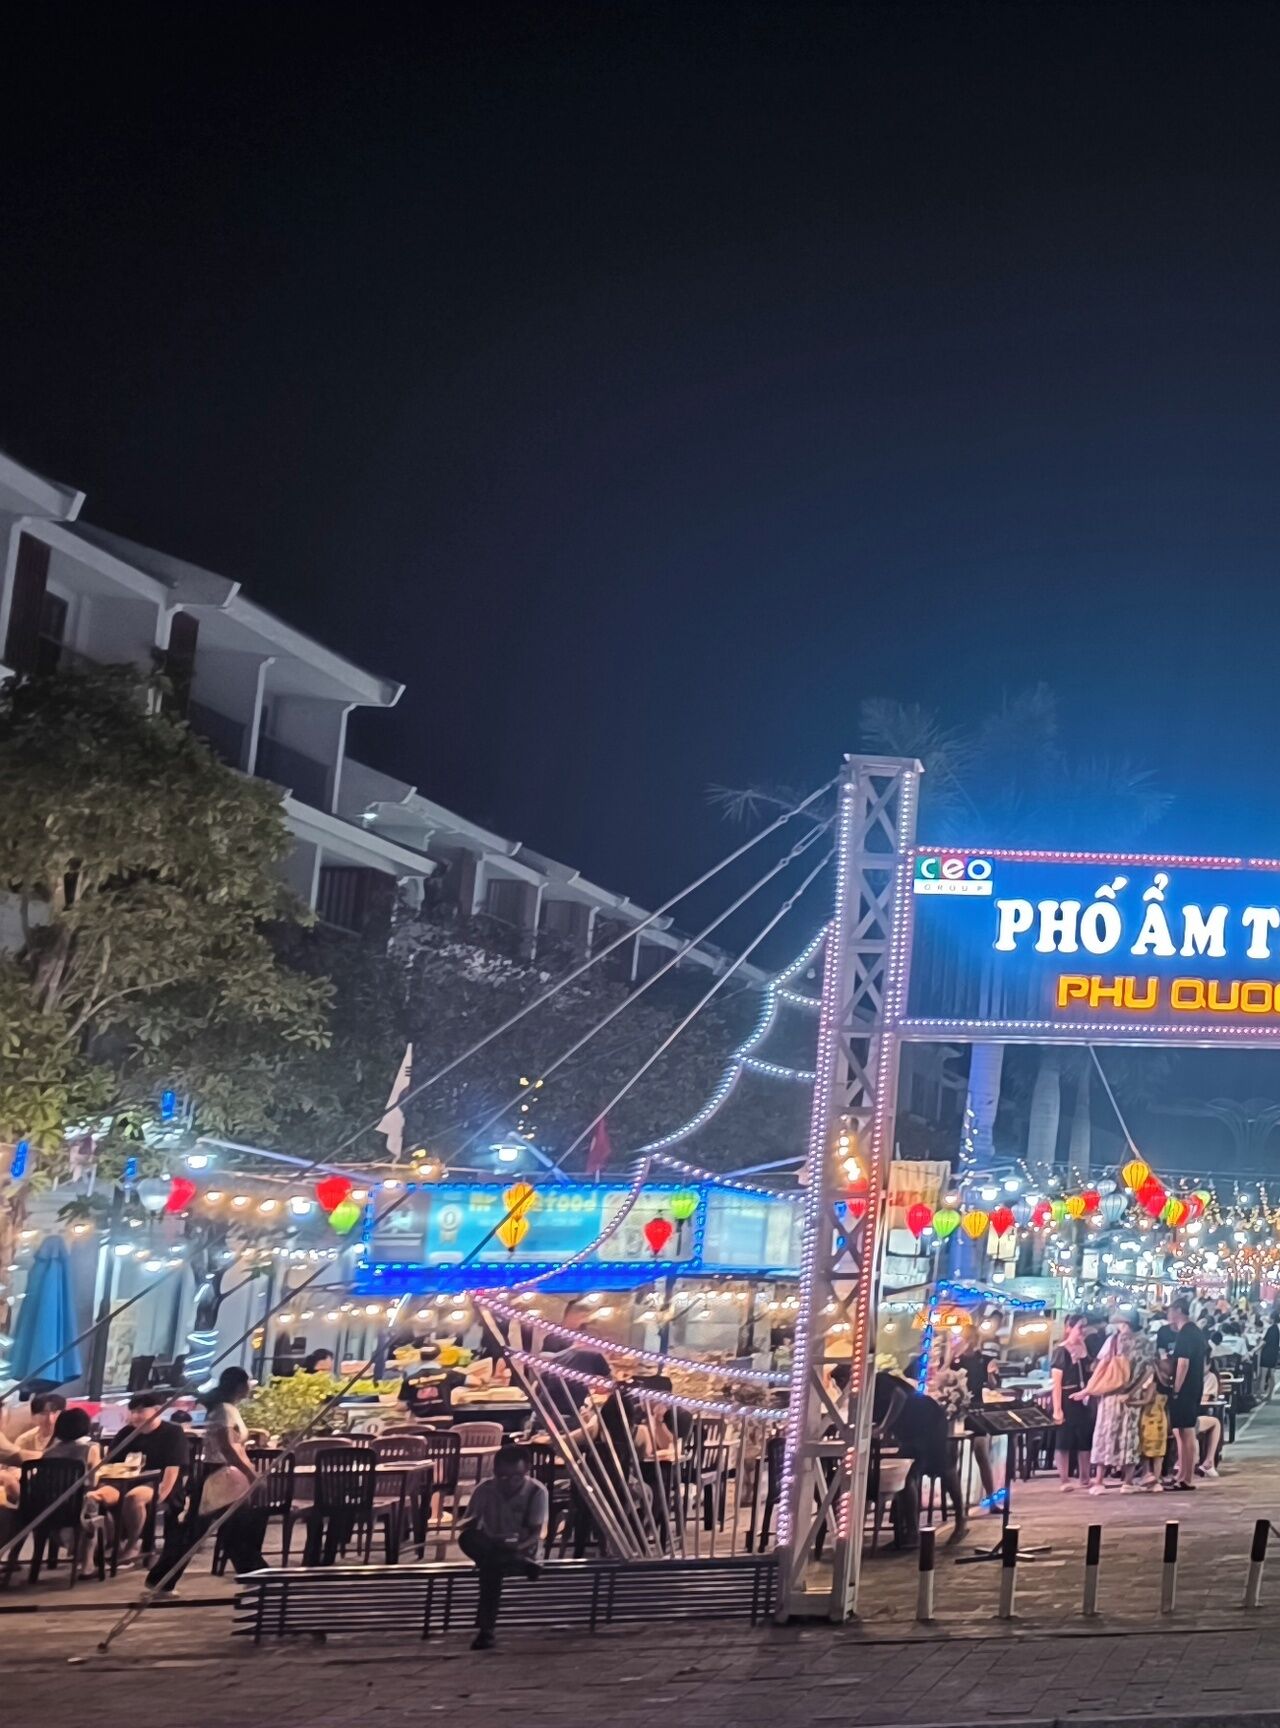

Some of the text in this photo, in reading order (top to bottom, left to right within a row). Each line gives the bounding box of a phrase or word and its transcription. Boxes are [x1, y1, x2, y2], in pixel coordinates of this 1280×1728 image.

[993, 875, 1128, 955] PHỐ
[1131, 872, 1230, 957] ẨM
[1058, 975, 1159, 1010] PHU
